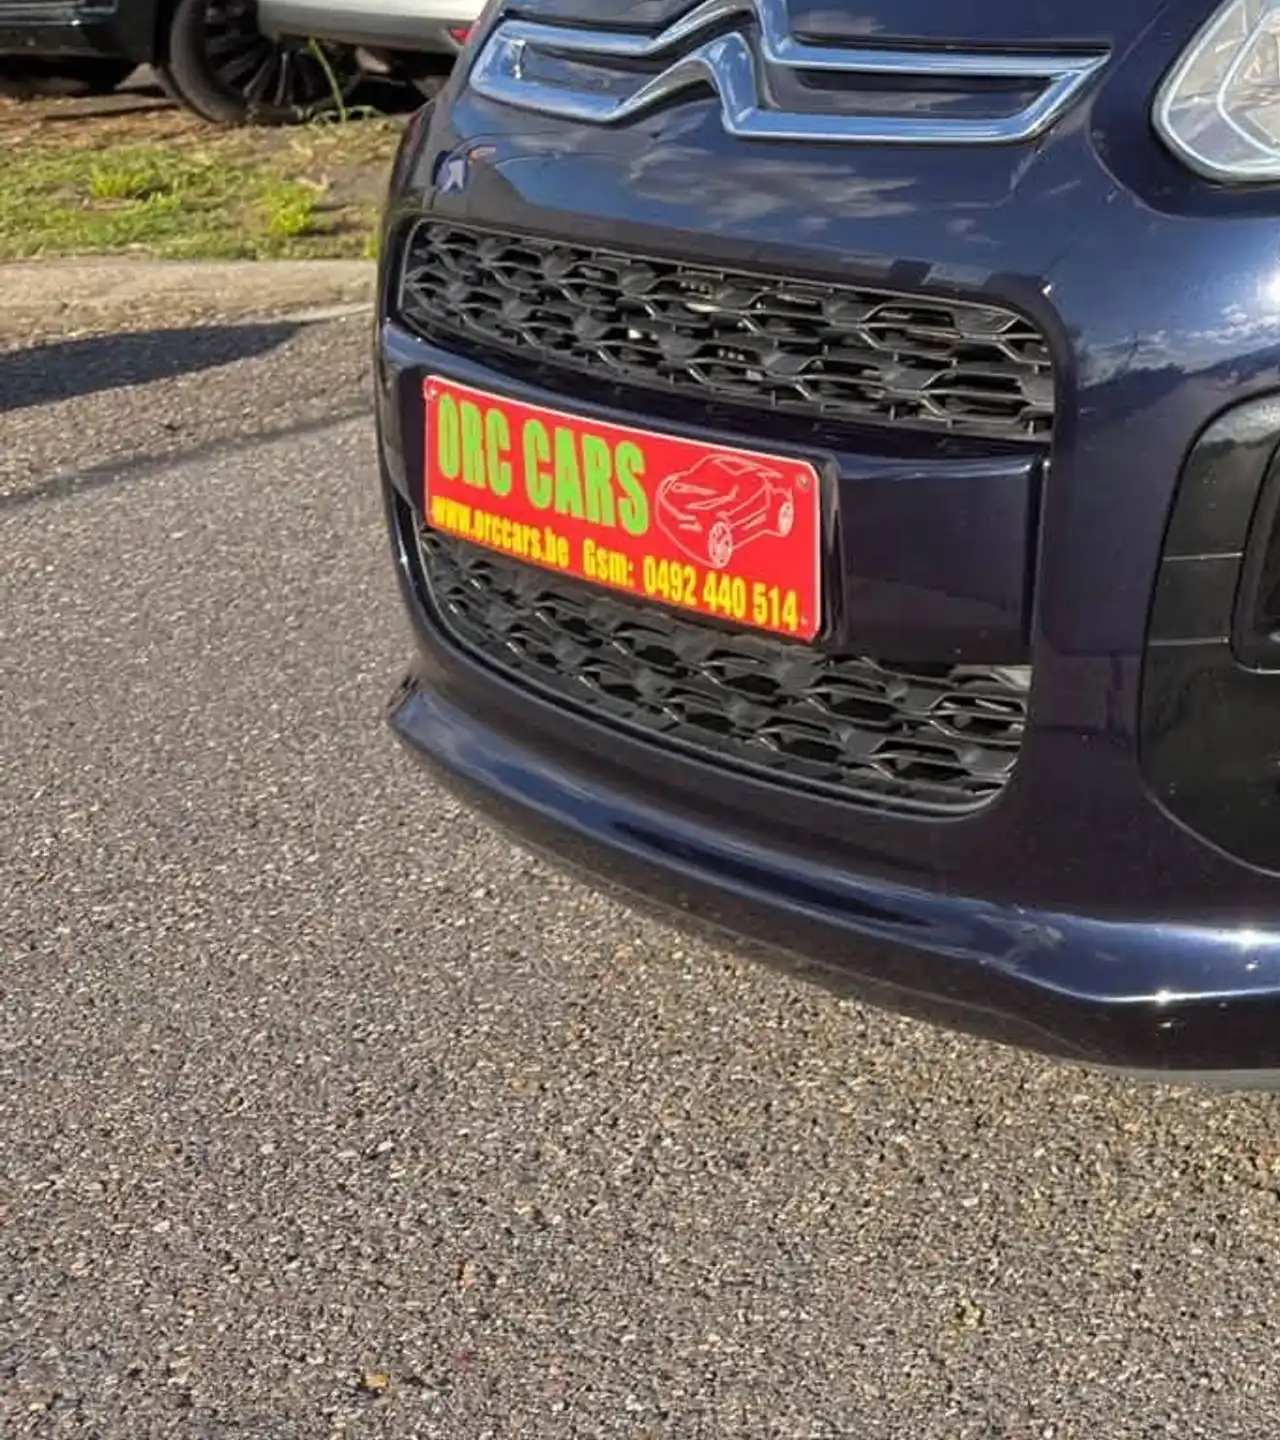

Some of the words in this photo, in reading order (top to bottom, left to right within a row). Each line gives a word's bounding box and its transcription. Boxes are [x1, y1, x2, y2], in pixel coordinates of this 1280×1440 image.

[438, 393, 512, 496] ORC
[523, 419, 649, 536] CARS
[432, 495, 569, 568] www.orccars.be
[583, 538, 634, 587] Gsm:
[643, 555, 697, 606] 0492
[703, 570, 747, 618] 440
[752, 581, 798, 632] 514
